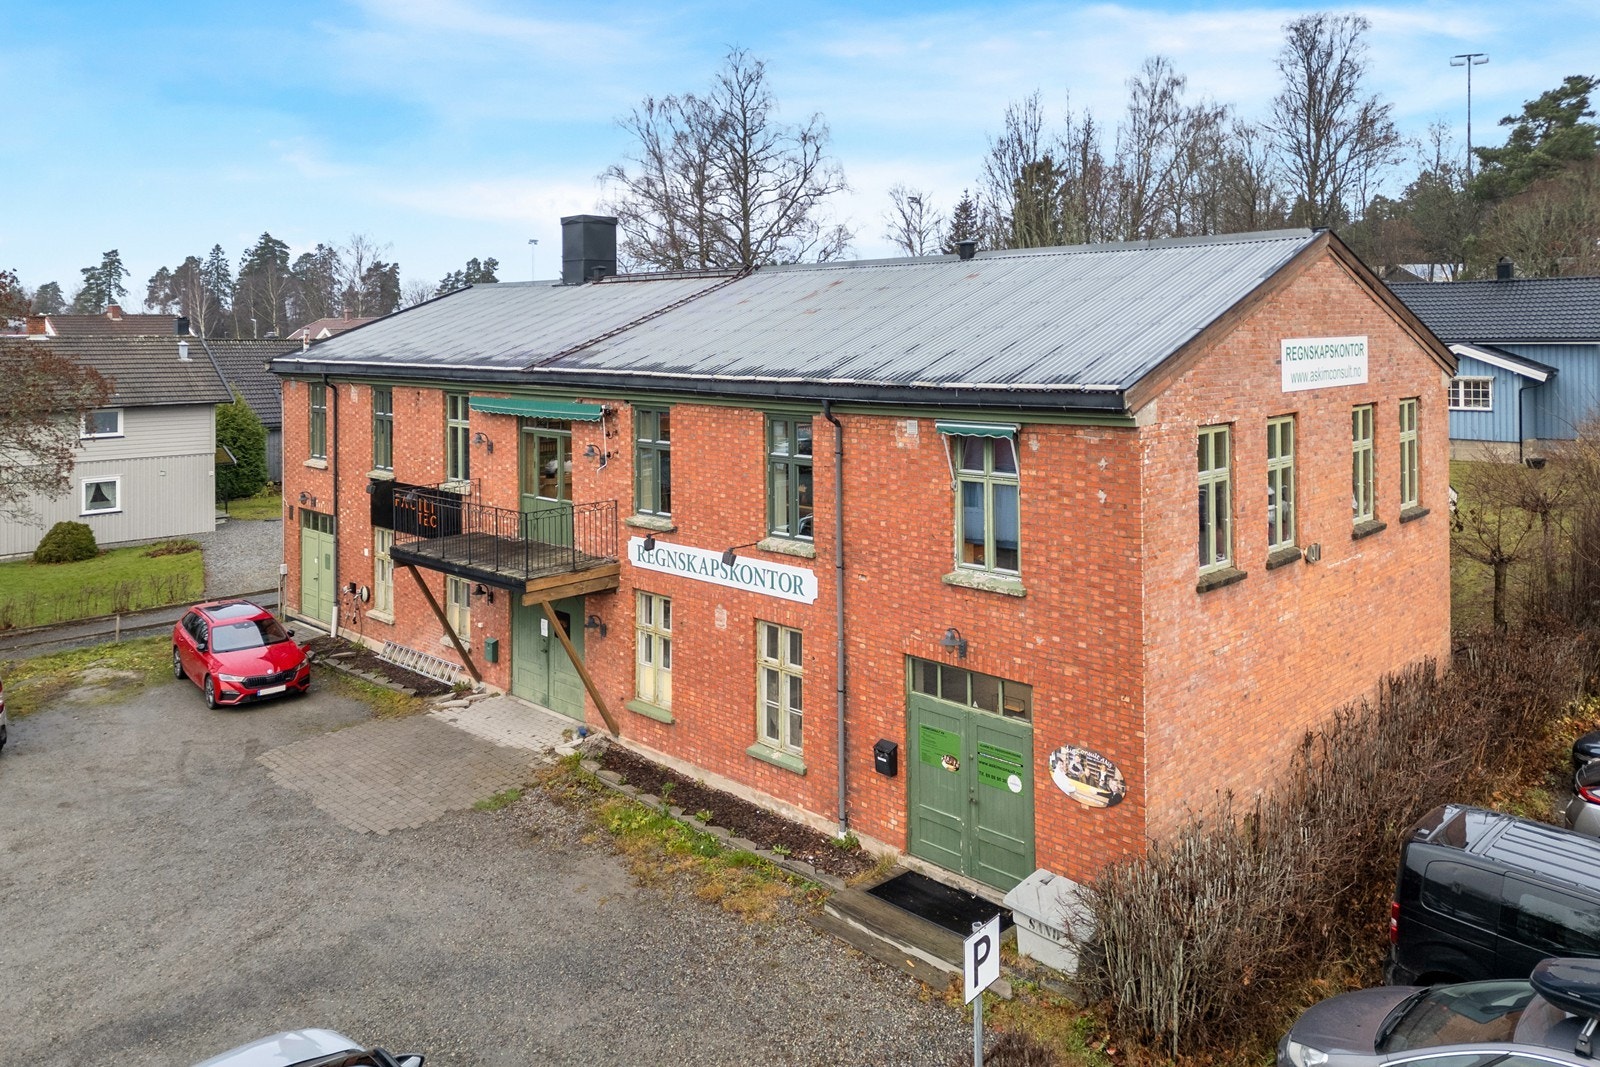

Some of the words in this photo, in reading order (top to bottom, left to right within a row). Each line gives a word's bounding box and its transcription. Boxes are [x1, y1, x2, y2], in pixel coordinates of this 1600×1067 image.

[1286, 343, 1365, 361] REGNSKAPSKONTOR
[1291, 365, 1361, 383] www.askimconsult.no
[418, 512, 437, 528] TEC
[637, 544, 805, 597] REGNSKAPSKONTOR
[973, 934, 991, 989] P
